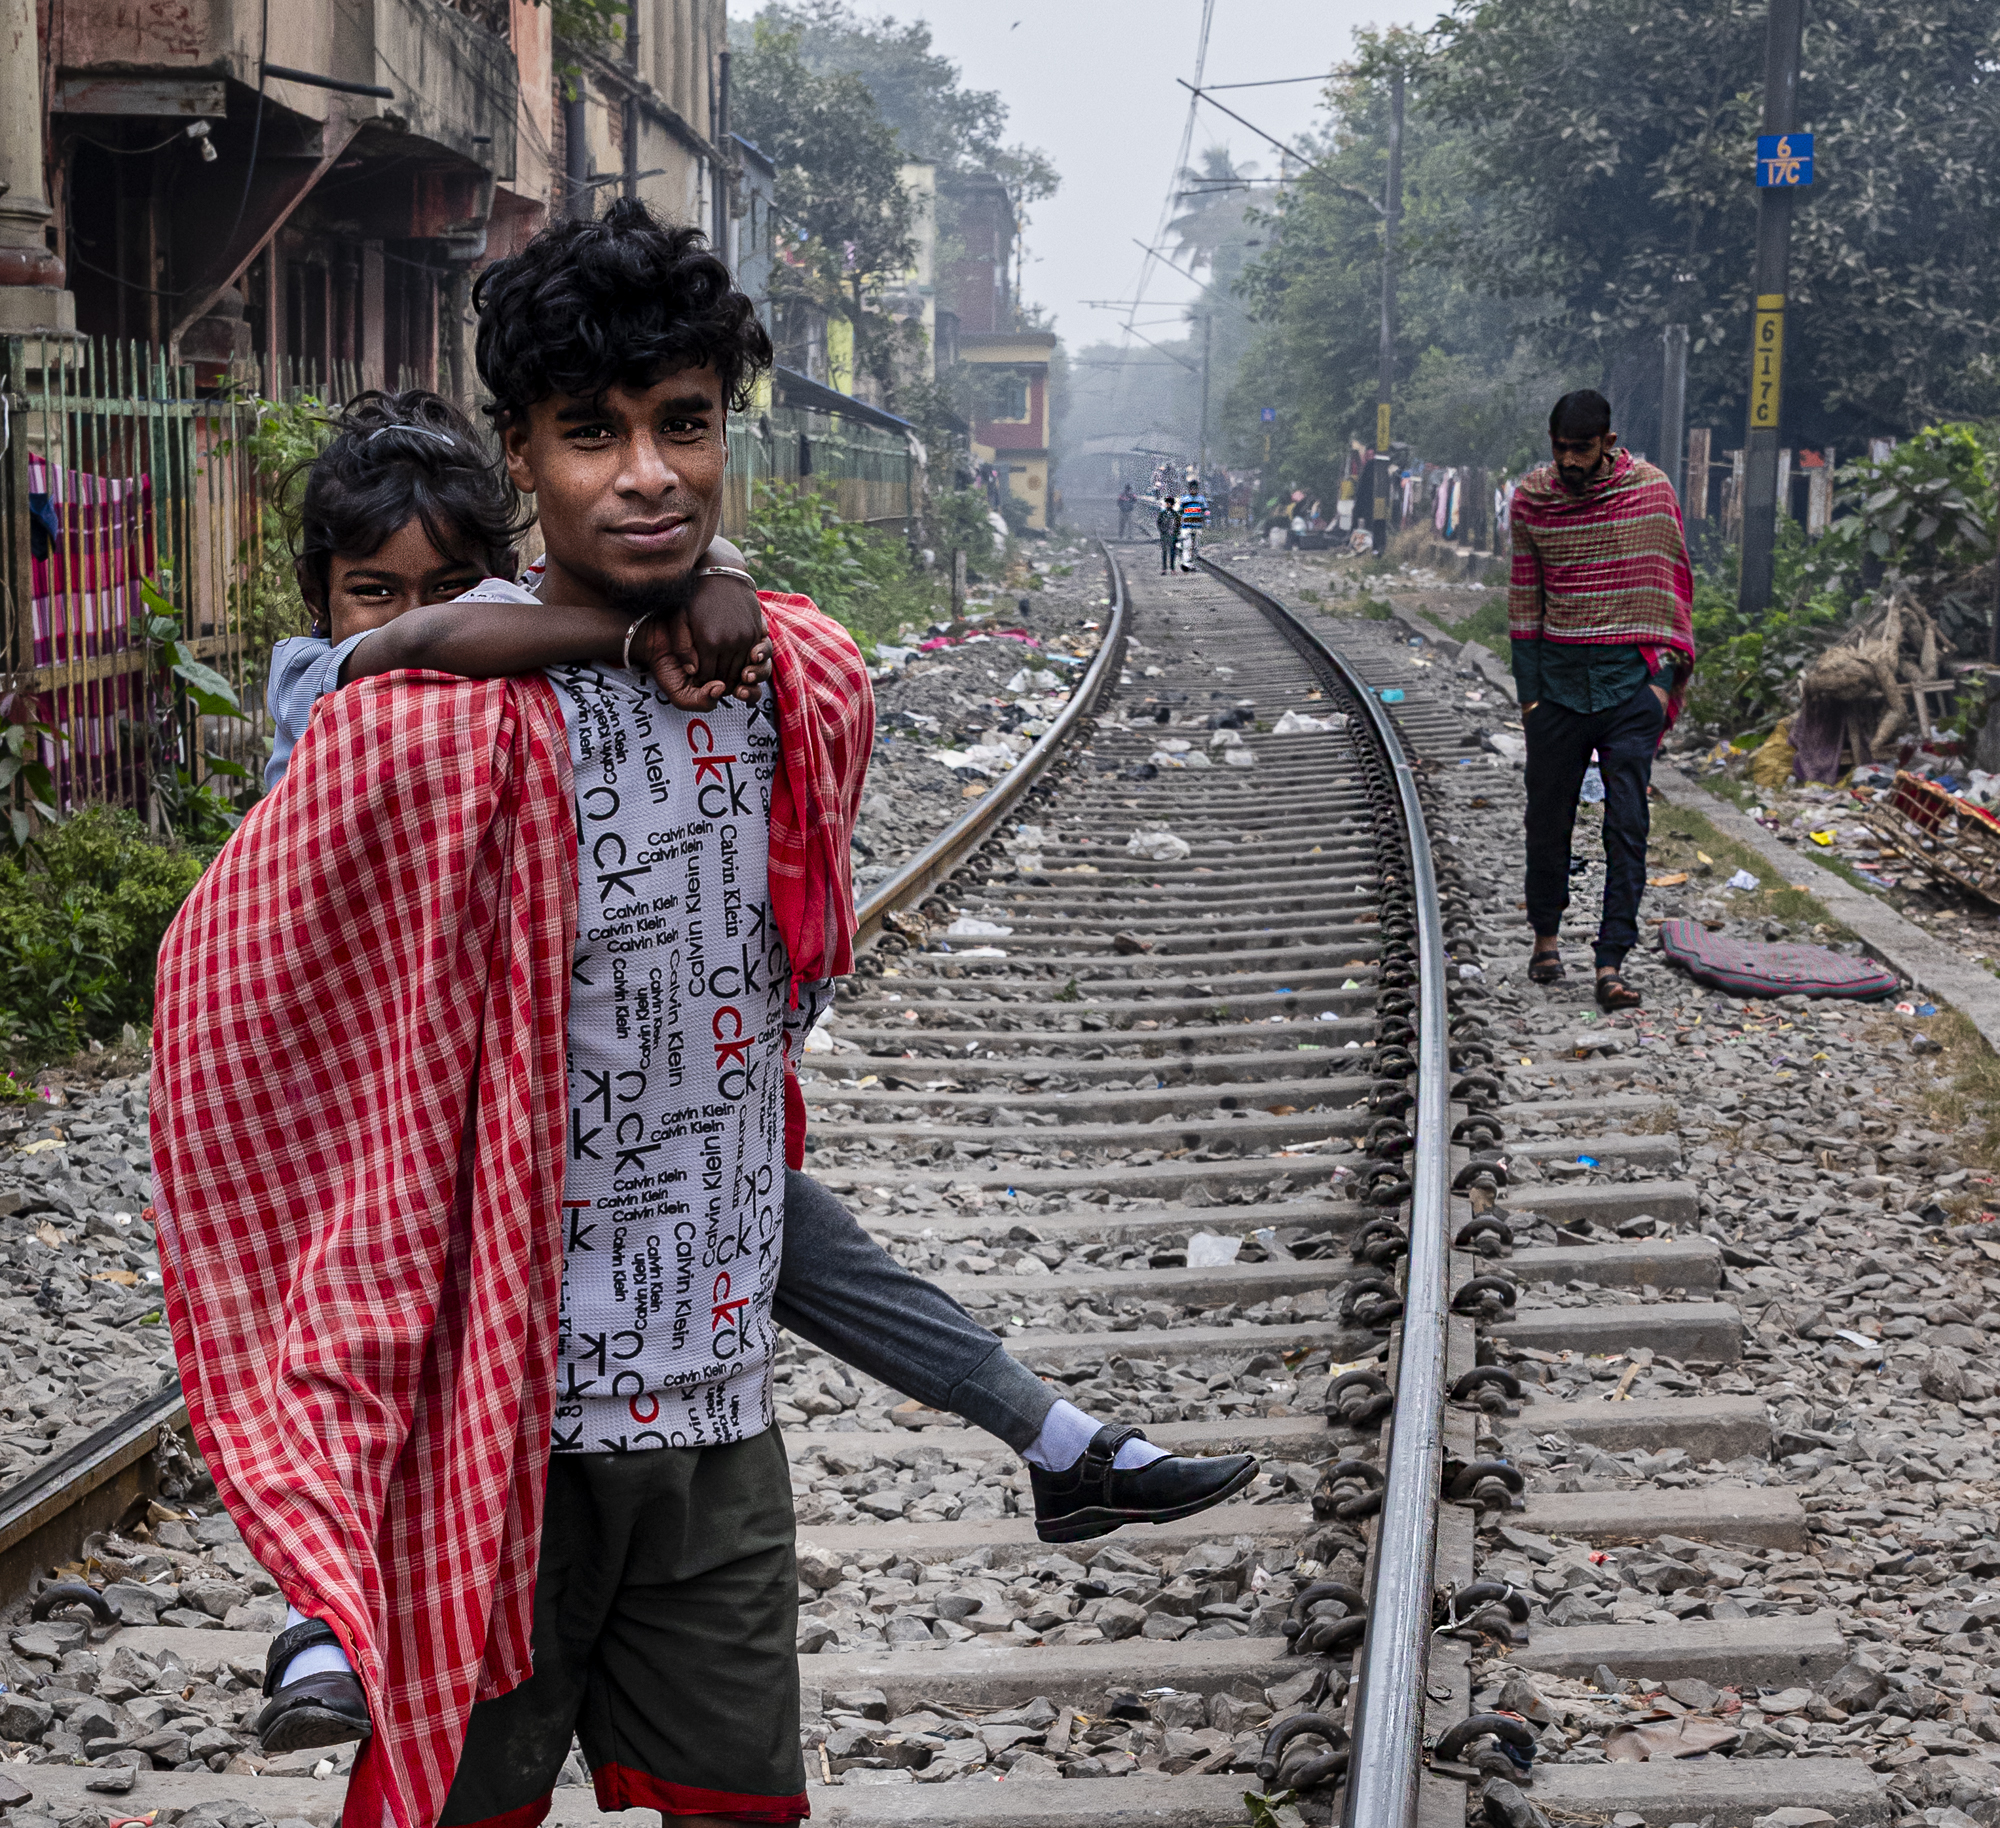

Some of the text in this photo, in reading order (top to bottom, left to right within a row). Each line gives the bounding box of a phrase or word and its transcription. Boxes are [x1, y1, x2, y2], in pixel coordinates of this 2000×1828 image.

[1768, 162, 1800, 185] 17C
[1777, 136, 1791, 158] 6
[579, 727, 595, 761] Klein
[591, 703, 618, 785] Calvin Klein
[613, 729, 629, 764] Klein
[687, 718, 737, 786] ck
[642, 743, 671, 804] Klein
[698, 762, 753, 818] ck
[637, 839, 703, 865] Calvin Klein
[647, 820, 713, 846] Calvin Klein
[593, 832, 652, 904] ck
[720, 824, 743, 938] Calvin Klein
[587, 916, 667, 942] Calvin Klein
[603, 894, 679, 921] Calvin Klein
[684, 855, 706, 997] Calvin Klein
[607, 937, 653, 953] Calvin
[708, 943, 762, 999] ck
[612, 958, 631, 1039] Calvin Klein
[649, 968, 664, 1014] Calvin
[667, 948, 687, 1087] Calvin Klein
[634, 987, 651, 1070] Calvin Klein
[712, 1006, 755, 1071] ck
[580, 1070, 647, 1123] ck
[718, 1047, 761, 1101] ck
[651, 1120, 725, 1142] Calvin Klein
[662, 1103, 735, 1125] Calvin Klein
[614, 1112, 661, 1176] ck
[597, 1188, 668, 1209] Calvin Klein
[613, 1168, 687, 1192] Calvin Klein
[700, 1135, 722, 1268] Calvin Klein
[612, 1200, 690, 1222] Calvin Klein
[612, 1227, 629, 1302] Calvin Klein
[717, 1212, 752, 1265] ck
[631, 1253, 647, 1330] Calvin Klein
[647, 1235, 663, 1313] Calvin Klein
[671, 1222, 696, 1350] Calvin Klein
[711, 1271, 749, 1332] ck
[577, 1330, 644, 1376] ck
[712, 1304, 755, 1360] ck
[664, 1369, 700, 1387] Calvin
[703, 1362, 726, 1378] Klein
[705, 1386, 716, 1419] Klein
[730, 1395, 740, 1427] Klein
